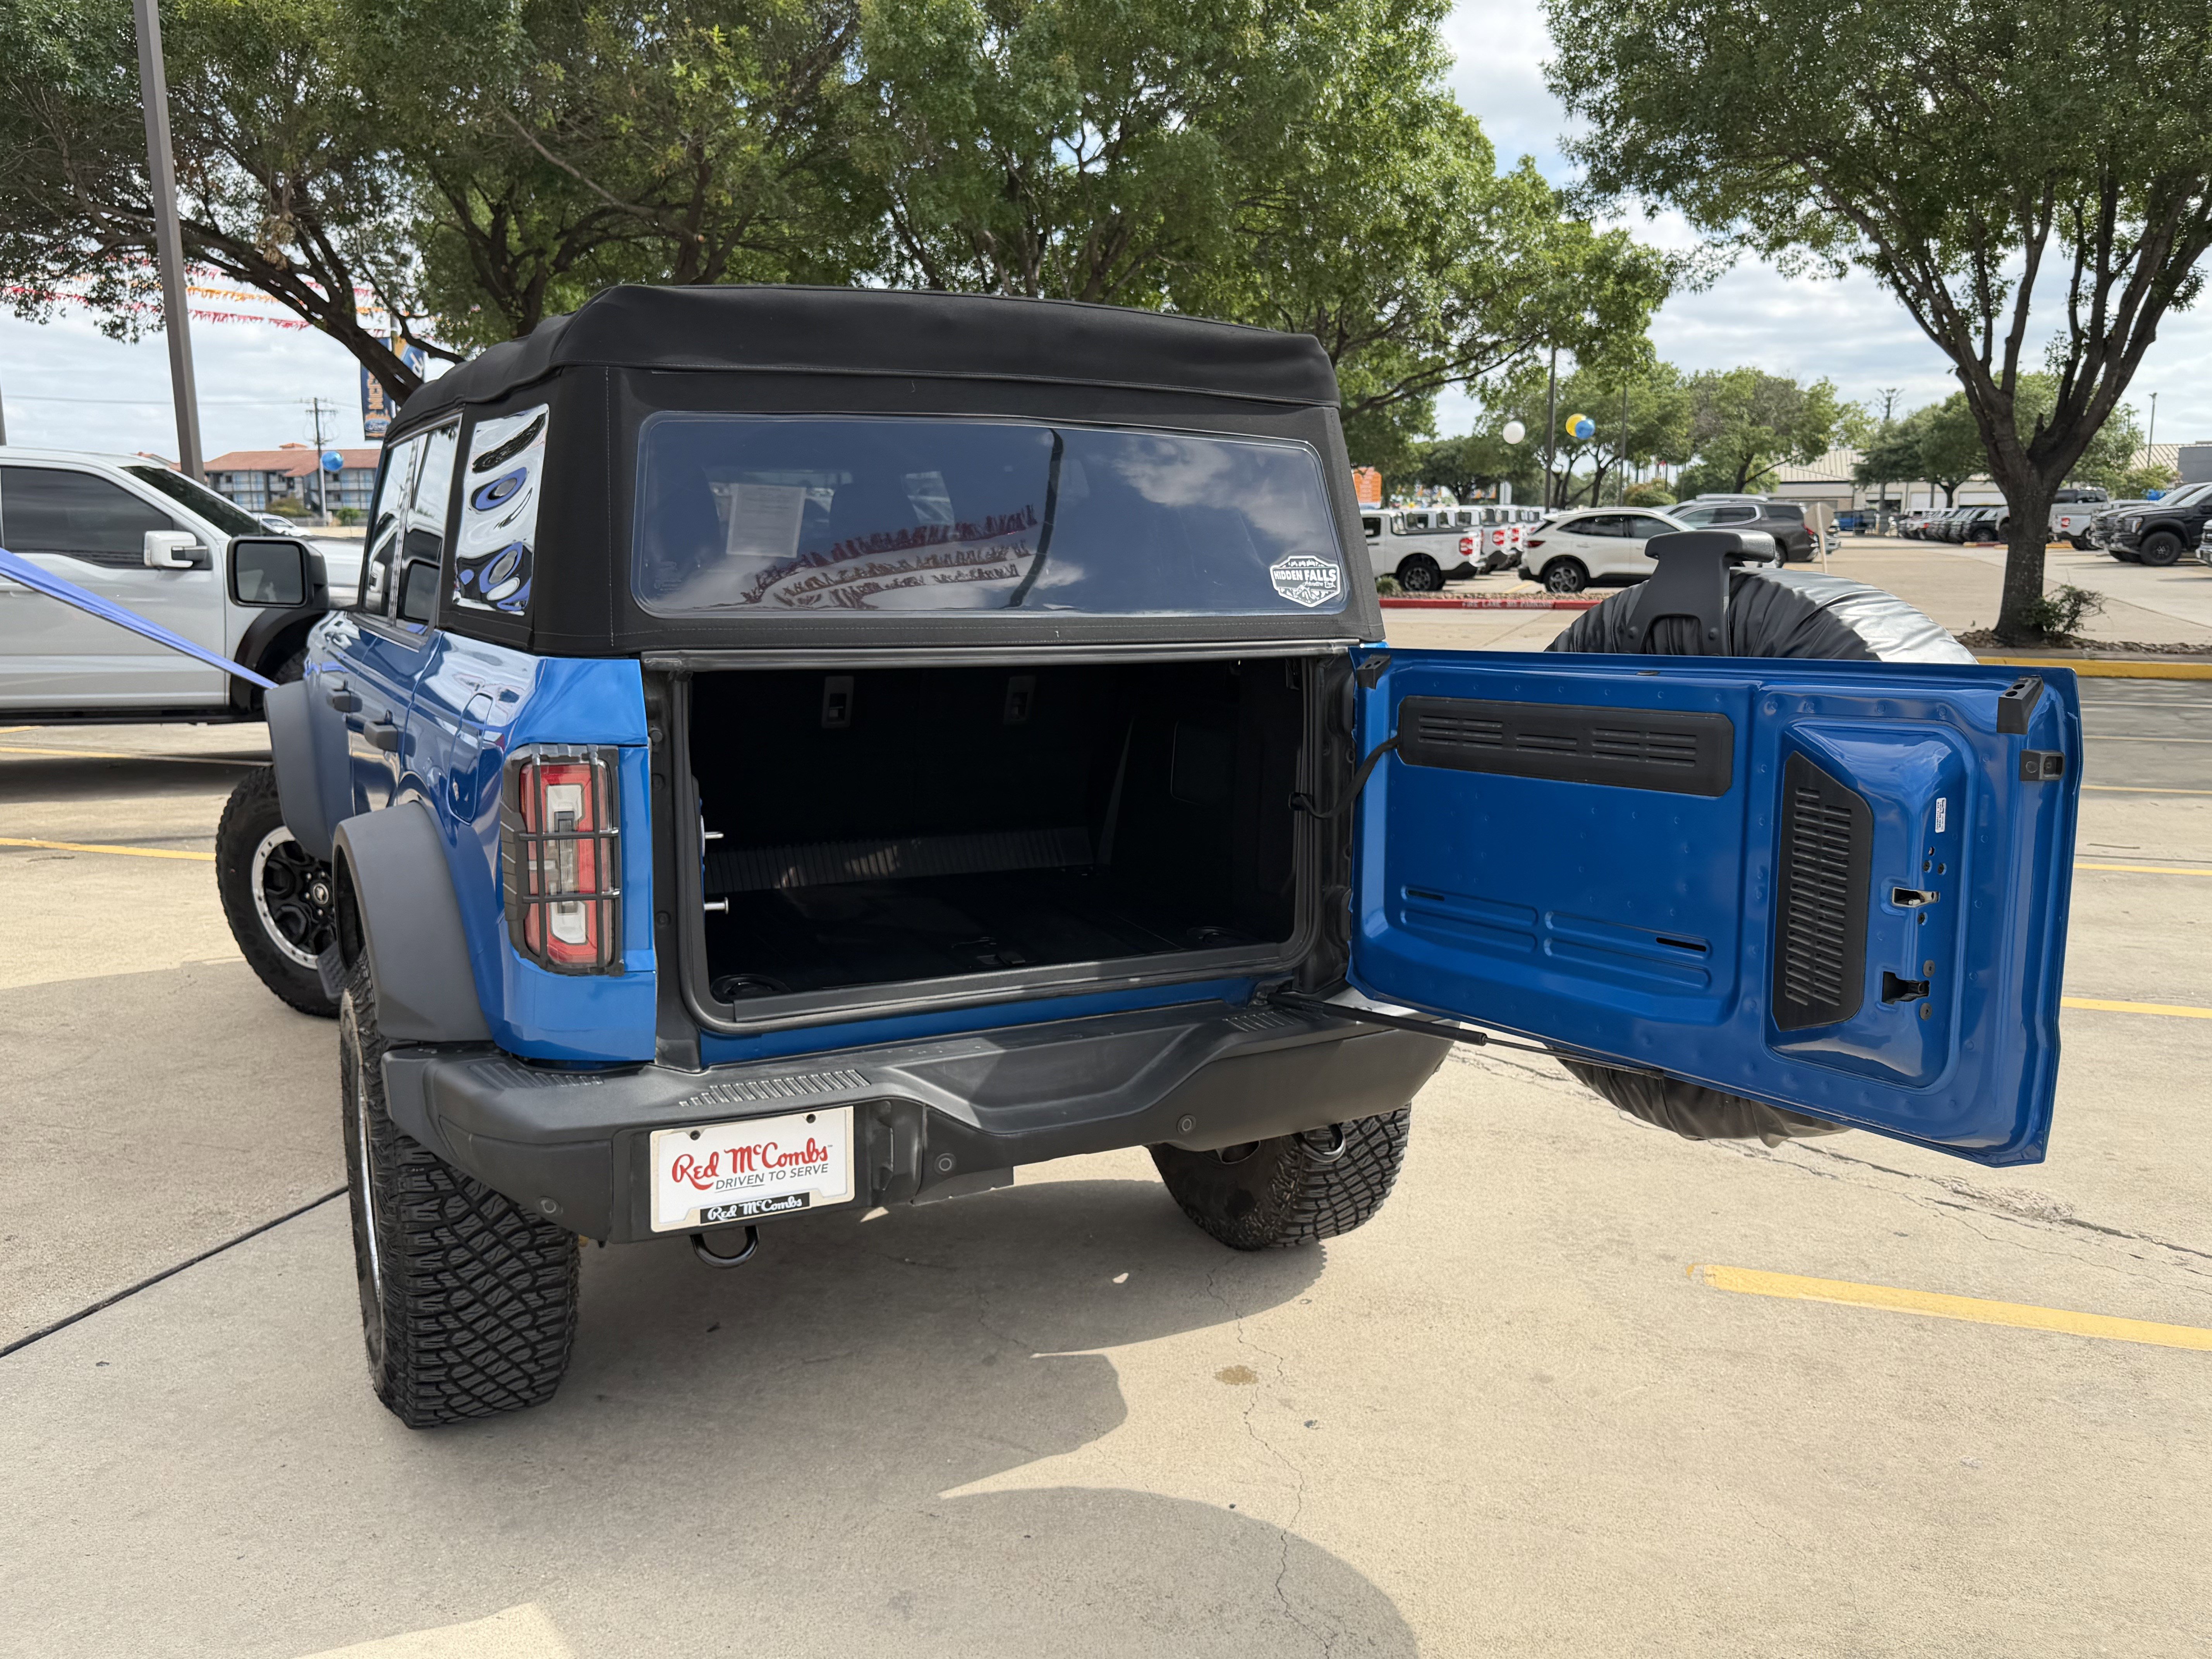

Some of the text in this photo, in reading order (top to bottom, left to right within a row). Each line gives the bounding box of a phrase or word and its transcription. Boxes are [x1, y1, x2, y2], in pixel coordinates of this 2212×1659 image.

[1274, 569, 1336, 581] HIDDEN FALLS
[672, 1137, 828, 1190] Red McCombs
[716, 1163, 829, 1190] DRIVEN TO SERVE
[708, 1196, 802, 1221] Red McCombs
